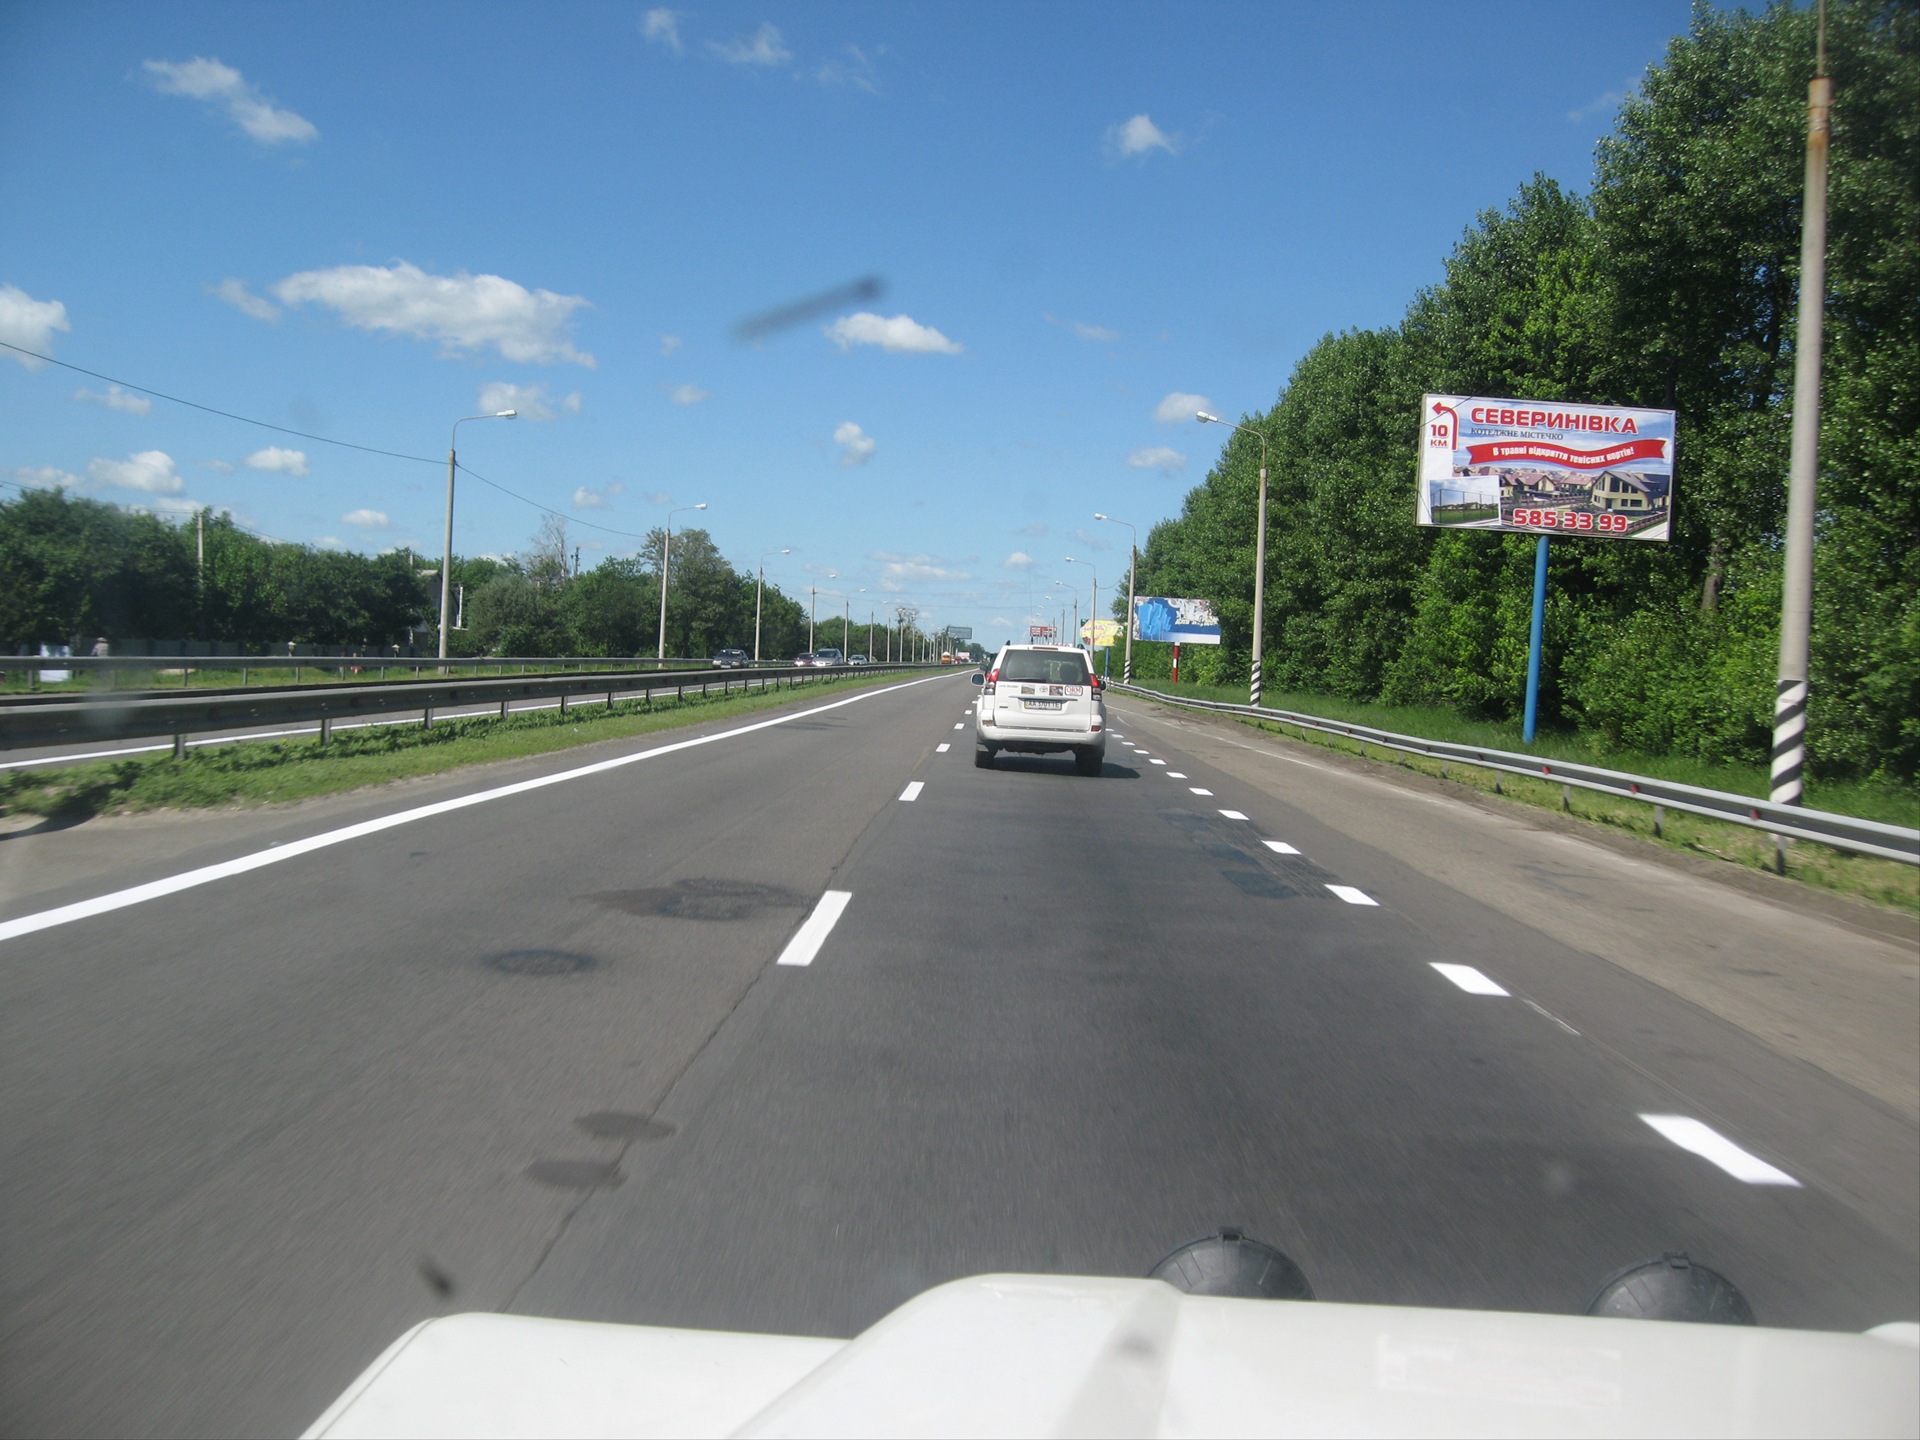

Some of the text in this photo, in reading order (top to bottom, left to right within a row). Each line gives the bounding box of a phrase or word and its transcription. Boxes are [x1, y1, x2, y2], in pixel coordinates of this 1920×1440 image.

[1471, 407, 1638, 434] СЕВЕРИНІВКА
[1430, 424, 1448, 437] 10
[1470, 427, 1564, 441] КОТЕДЖНЕ МІСТЕЧКО
[1492, 446, 1499, 456] В
[1513, 508, 1628, 532] 585 33 99
